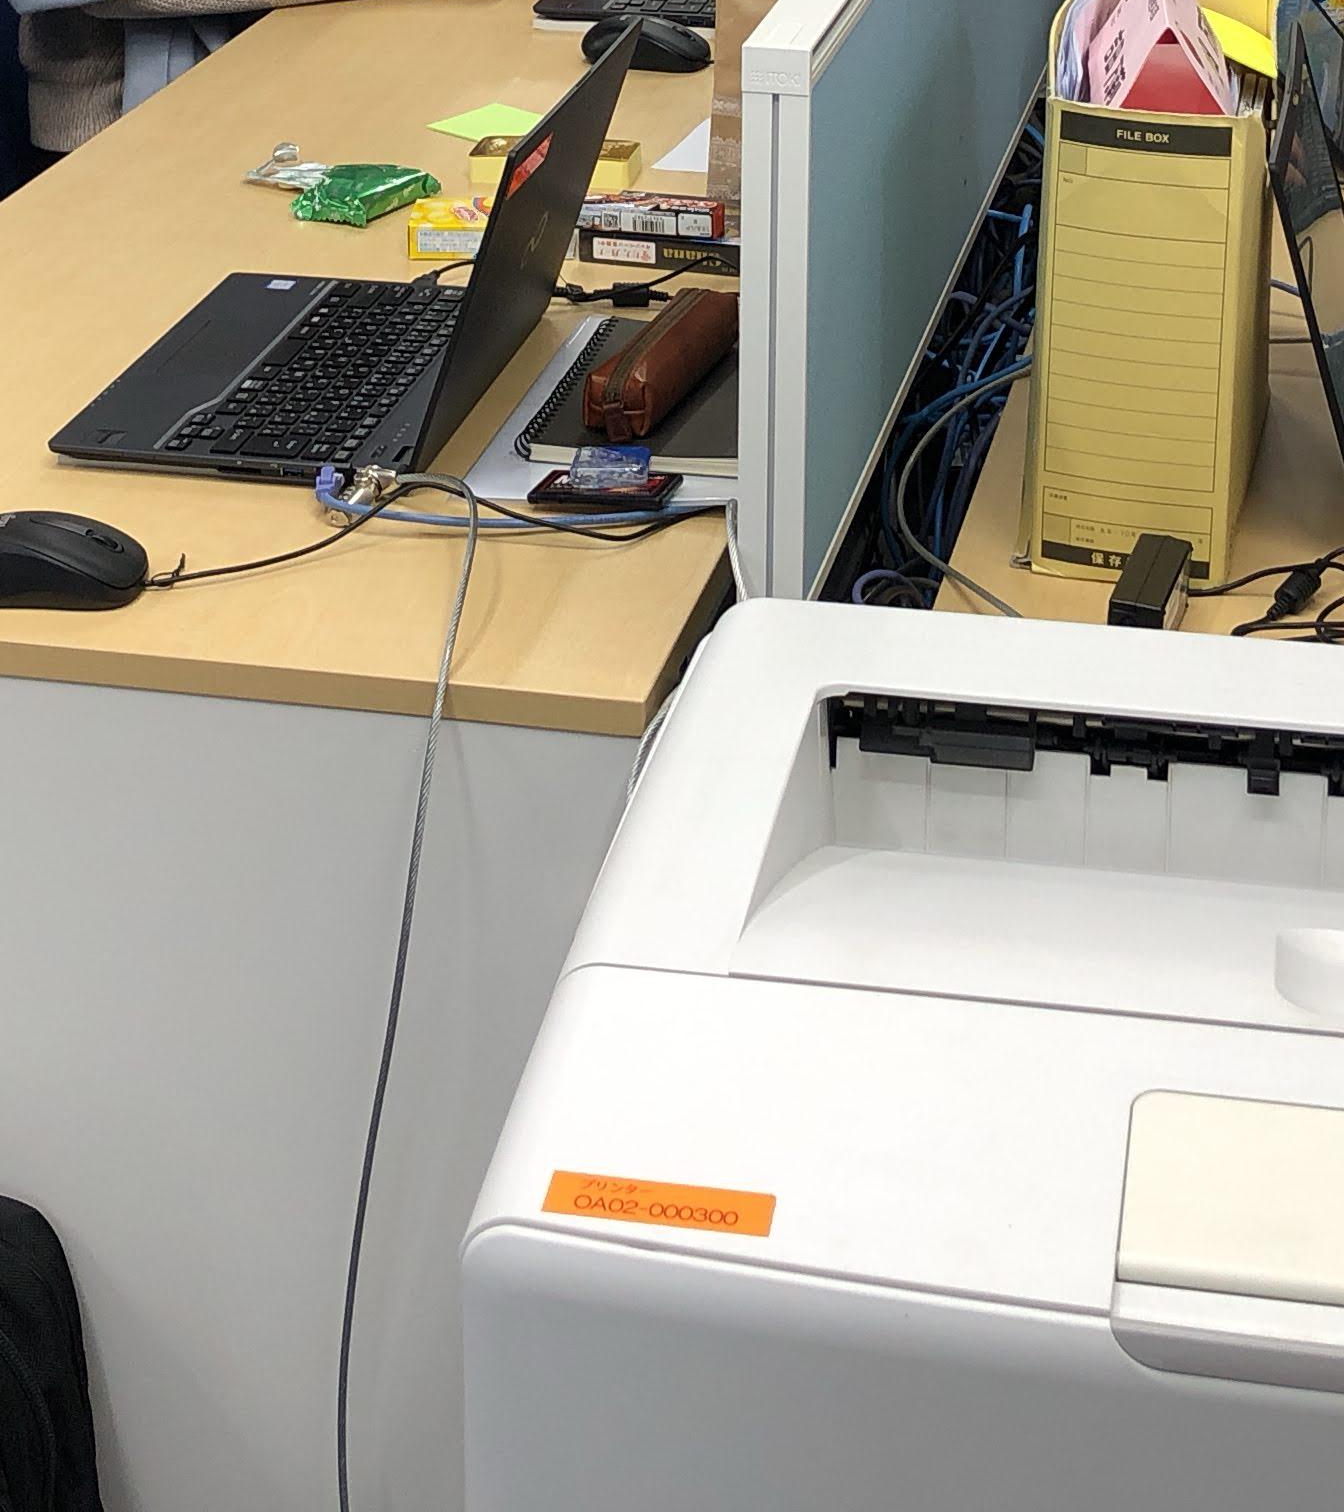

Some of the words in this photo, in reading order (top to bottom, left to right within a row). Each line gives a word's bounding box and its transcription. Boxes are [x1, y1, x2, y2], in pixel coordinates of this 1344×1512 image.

[1116, 129, 1142, 142] FILE
[1145, 132, 1170, 144] BOX
[1091, 552, 1122, 568] 保存
[580, 1179, 654, 1195] プリンター
[573, 1194, 739, 1227] OA02-000300
